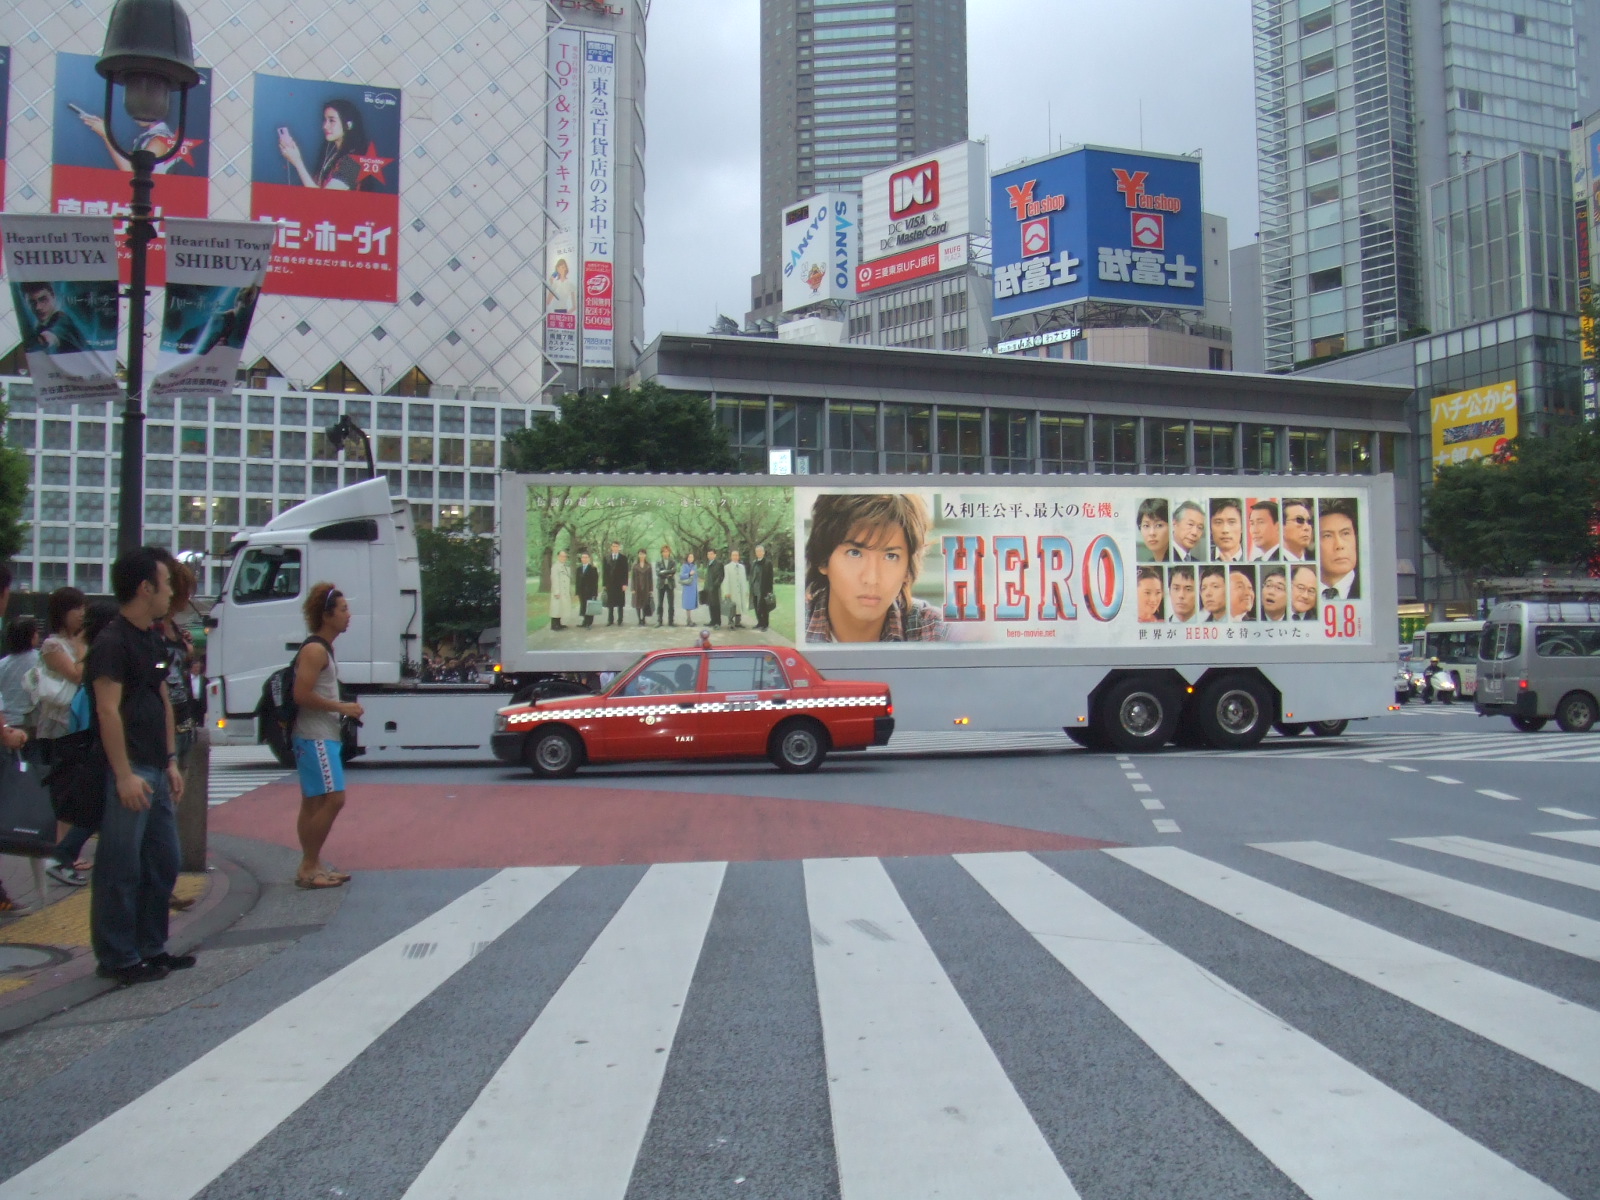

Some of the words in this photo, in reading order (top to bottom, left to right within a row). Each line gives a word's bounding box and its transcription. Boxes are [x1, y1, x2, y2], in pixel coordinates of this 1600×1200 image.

[587, 64, 613, 75] 2007
[589, 77, 608, 255] 東急百貨店のお中元
[893, 168, 933, 213] DC
[6, 232, 67, 243] Heartful
[72, 232, 110, 243] Town
[880, 237, 894, 250] DC
[896, 221, 948, 245] MasterCard
[888, 221, 903, 236] DC
[905, 214, 926, 230] VISA
[170, 235, 229, 248] Heartful
[234, 239, 270, 250] Town
[784, 206, 827, 278] SANKYO
[835, 201, 854, 289] SANKYO
[13, 250, 107, 265] SHIBUYA
[175, 253, 262, 271] SHIBUYA
[875, 254, 935, 279] 三菱東京UFJ銀行
[1098, 247, 1197, 288] 武富士
[994, 250, 1079, 299] 武富士
[1071, 328, 1080, 338] 9F
[1432, 384, 1517, 423] ハチ公から
[943, 502, 1120, 519] 久利生公平、最大の危機。
[942, 534, 1124, 622] HERO
[1006, 628, 1056, 638] hero-movie.net
[1324, 604, 1357, 638] 9.8
